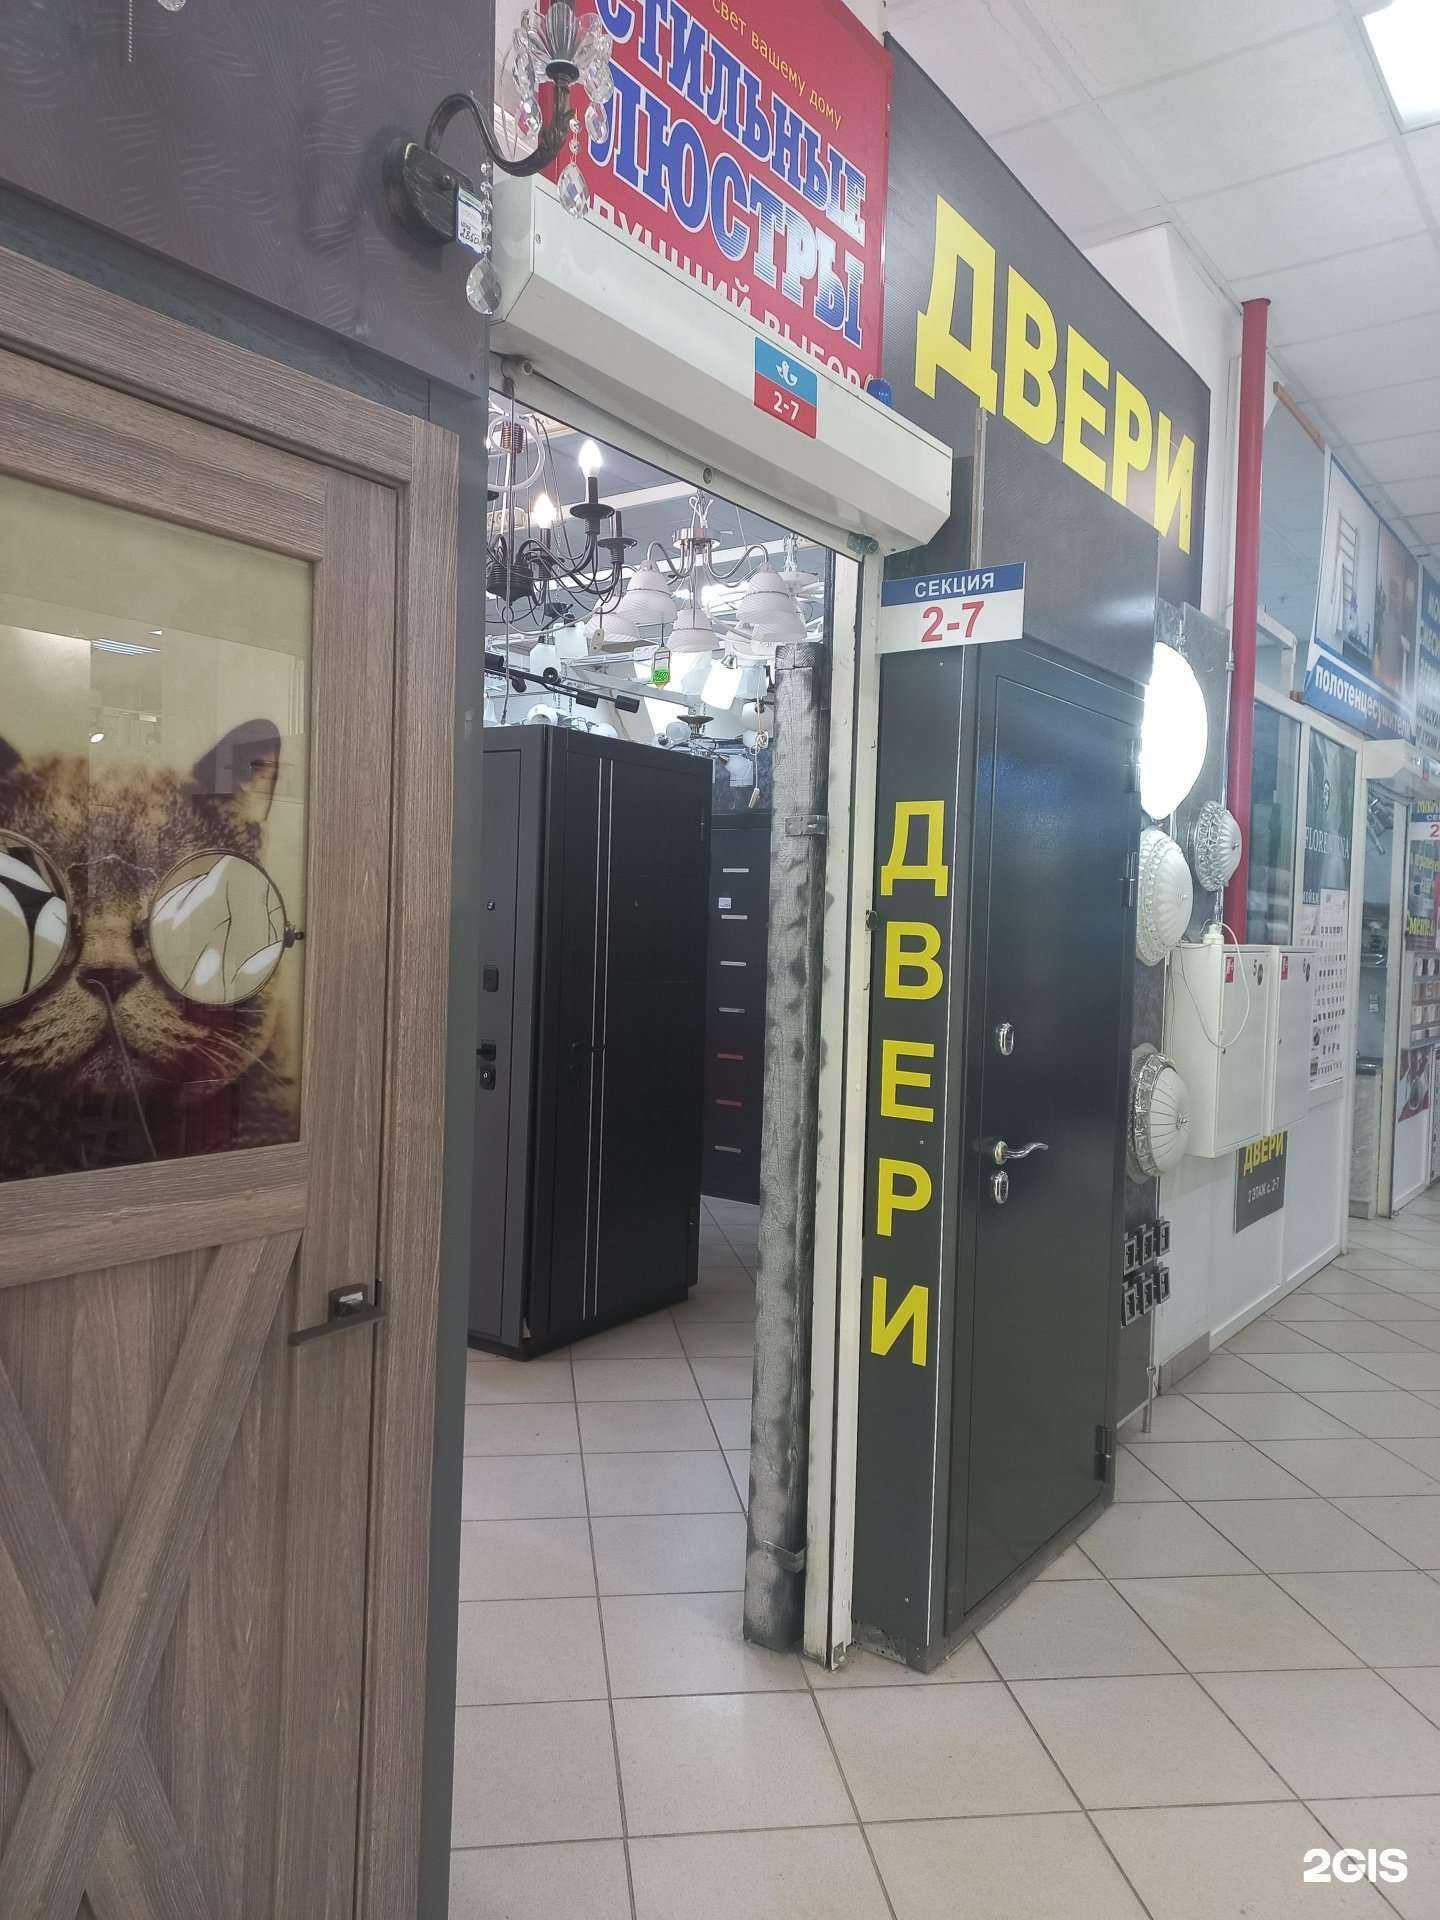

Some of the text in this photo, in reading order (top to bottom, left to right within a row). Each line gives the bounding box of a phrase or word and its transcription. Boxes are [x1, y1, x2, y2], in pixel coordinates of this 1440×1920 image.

[751, 30, 806, 97] вашему
[809, 89, 843, 131] дому
[588, 58, 865, 349] ЛЮСТРЫ
[773, 391, 800, 421] 2-7
[914, 194, 1196, 555] ДВЕРИ
[915, 572, 995, 598] СЕКЦИЯ
[921, 601, 985, 643] 2-7
[870, 800, 949, 1367] ДВЕРИ
[1243, 1133, 1284, 1176] ДВЕРИ
